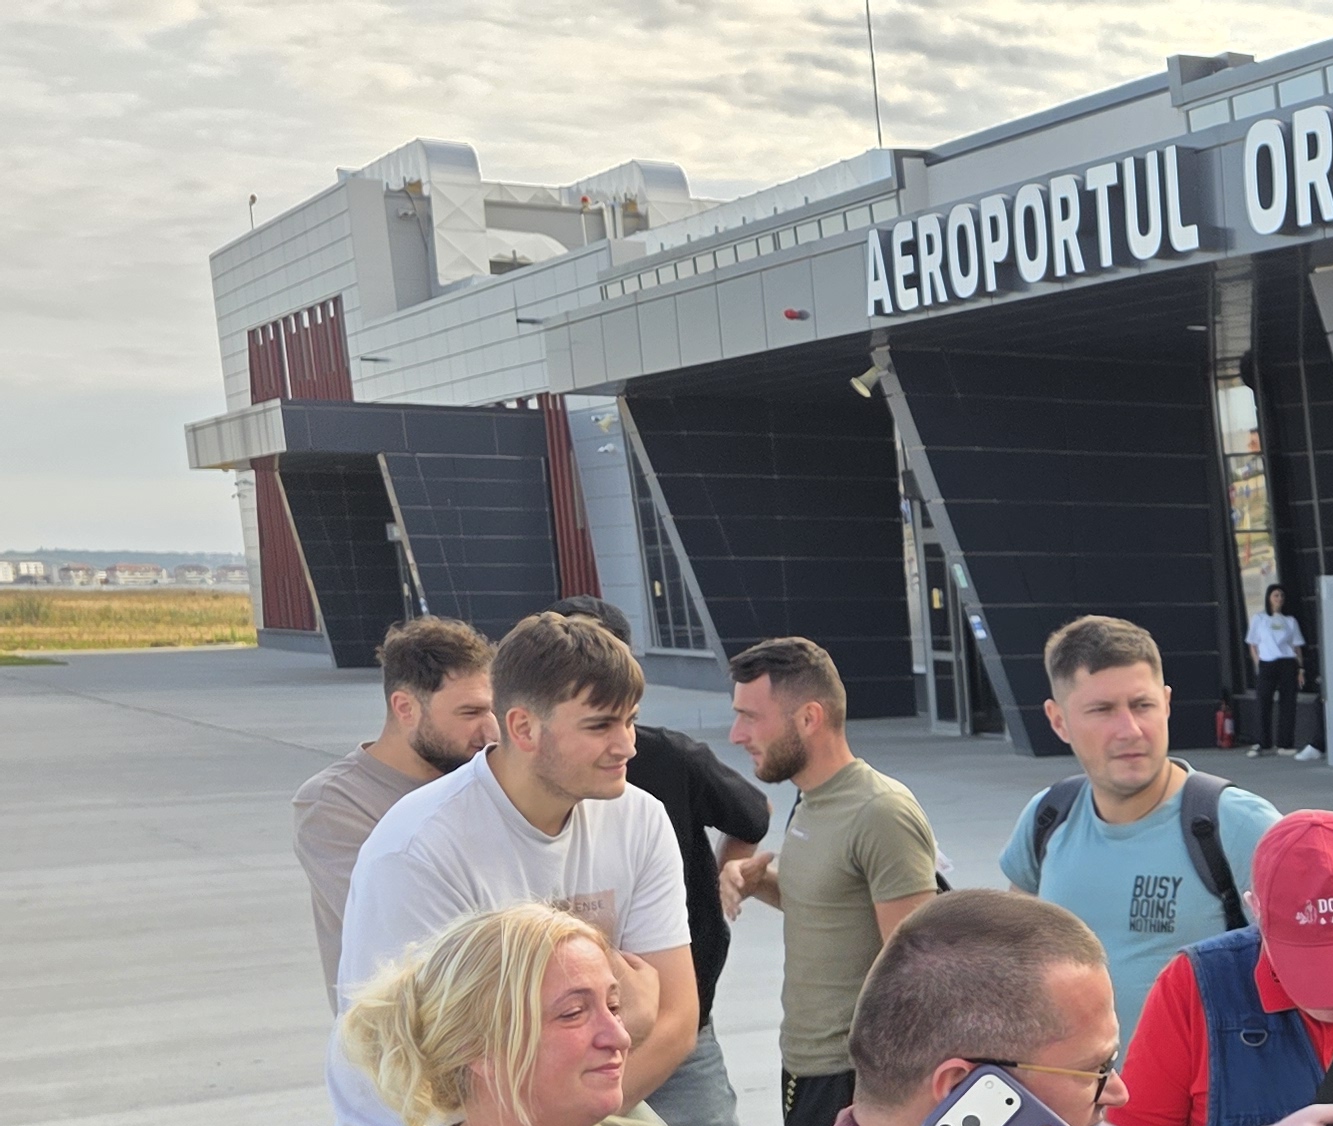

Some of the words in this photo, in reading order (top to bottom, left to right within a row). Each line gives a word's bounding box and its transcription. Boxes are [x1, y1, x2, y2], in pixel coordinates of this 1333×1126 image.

[866, 144, 1200, 317] AEROPORTUL
[1133, 875, 1183, 900] BUSY
[1129, 899, 1177, 919] DOING
[1128, 918, 1176, 933] NOTHING
